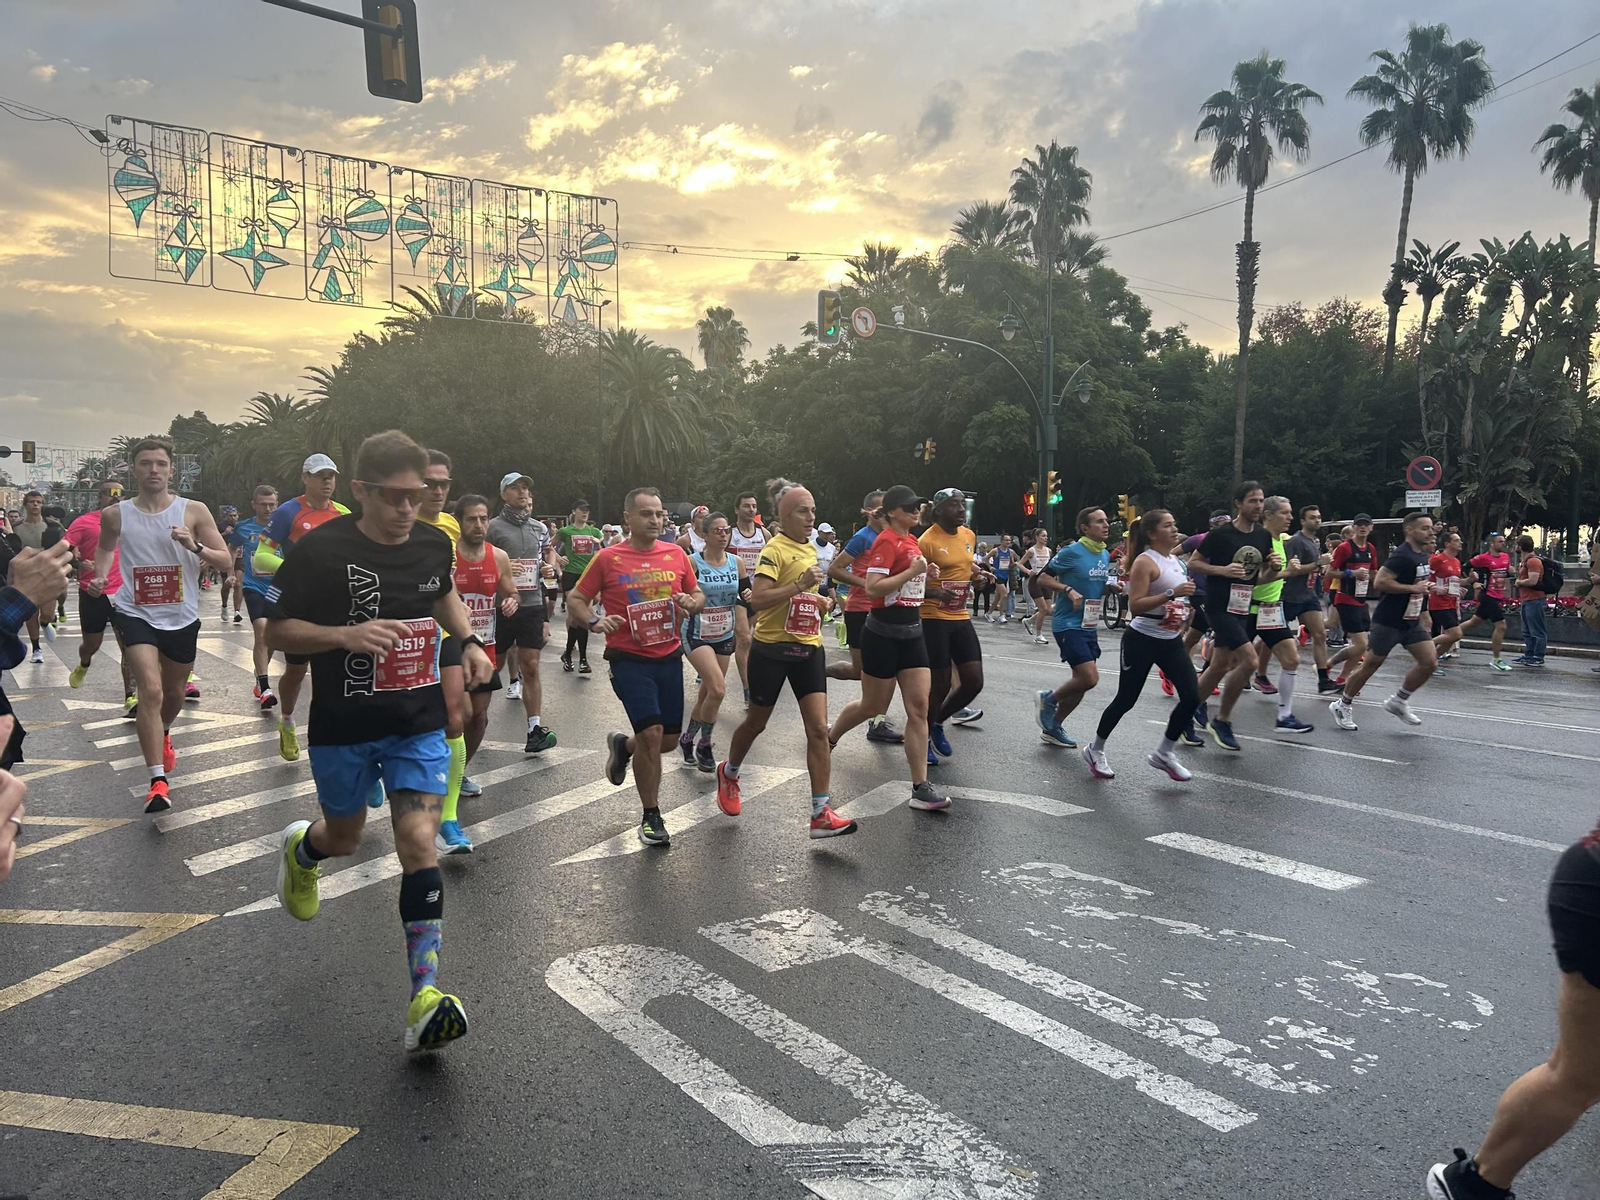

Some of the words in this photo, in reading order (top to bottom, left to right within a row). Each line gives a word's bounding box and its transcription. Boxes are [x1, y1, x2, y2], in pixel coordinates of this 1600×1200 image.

[144, 575, 167, 584] 2681
[618, 570, 676, 586] MADRID
[704, 572, 737, 584] nerja
[641, 611, 663, 622] 4726
[407, 620, 434, 632] NERALI
[395, 636, 425, 652] 3519
